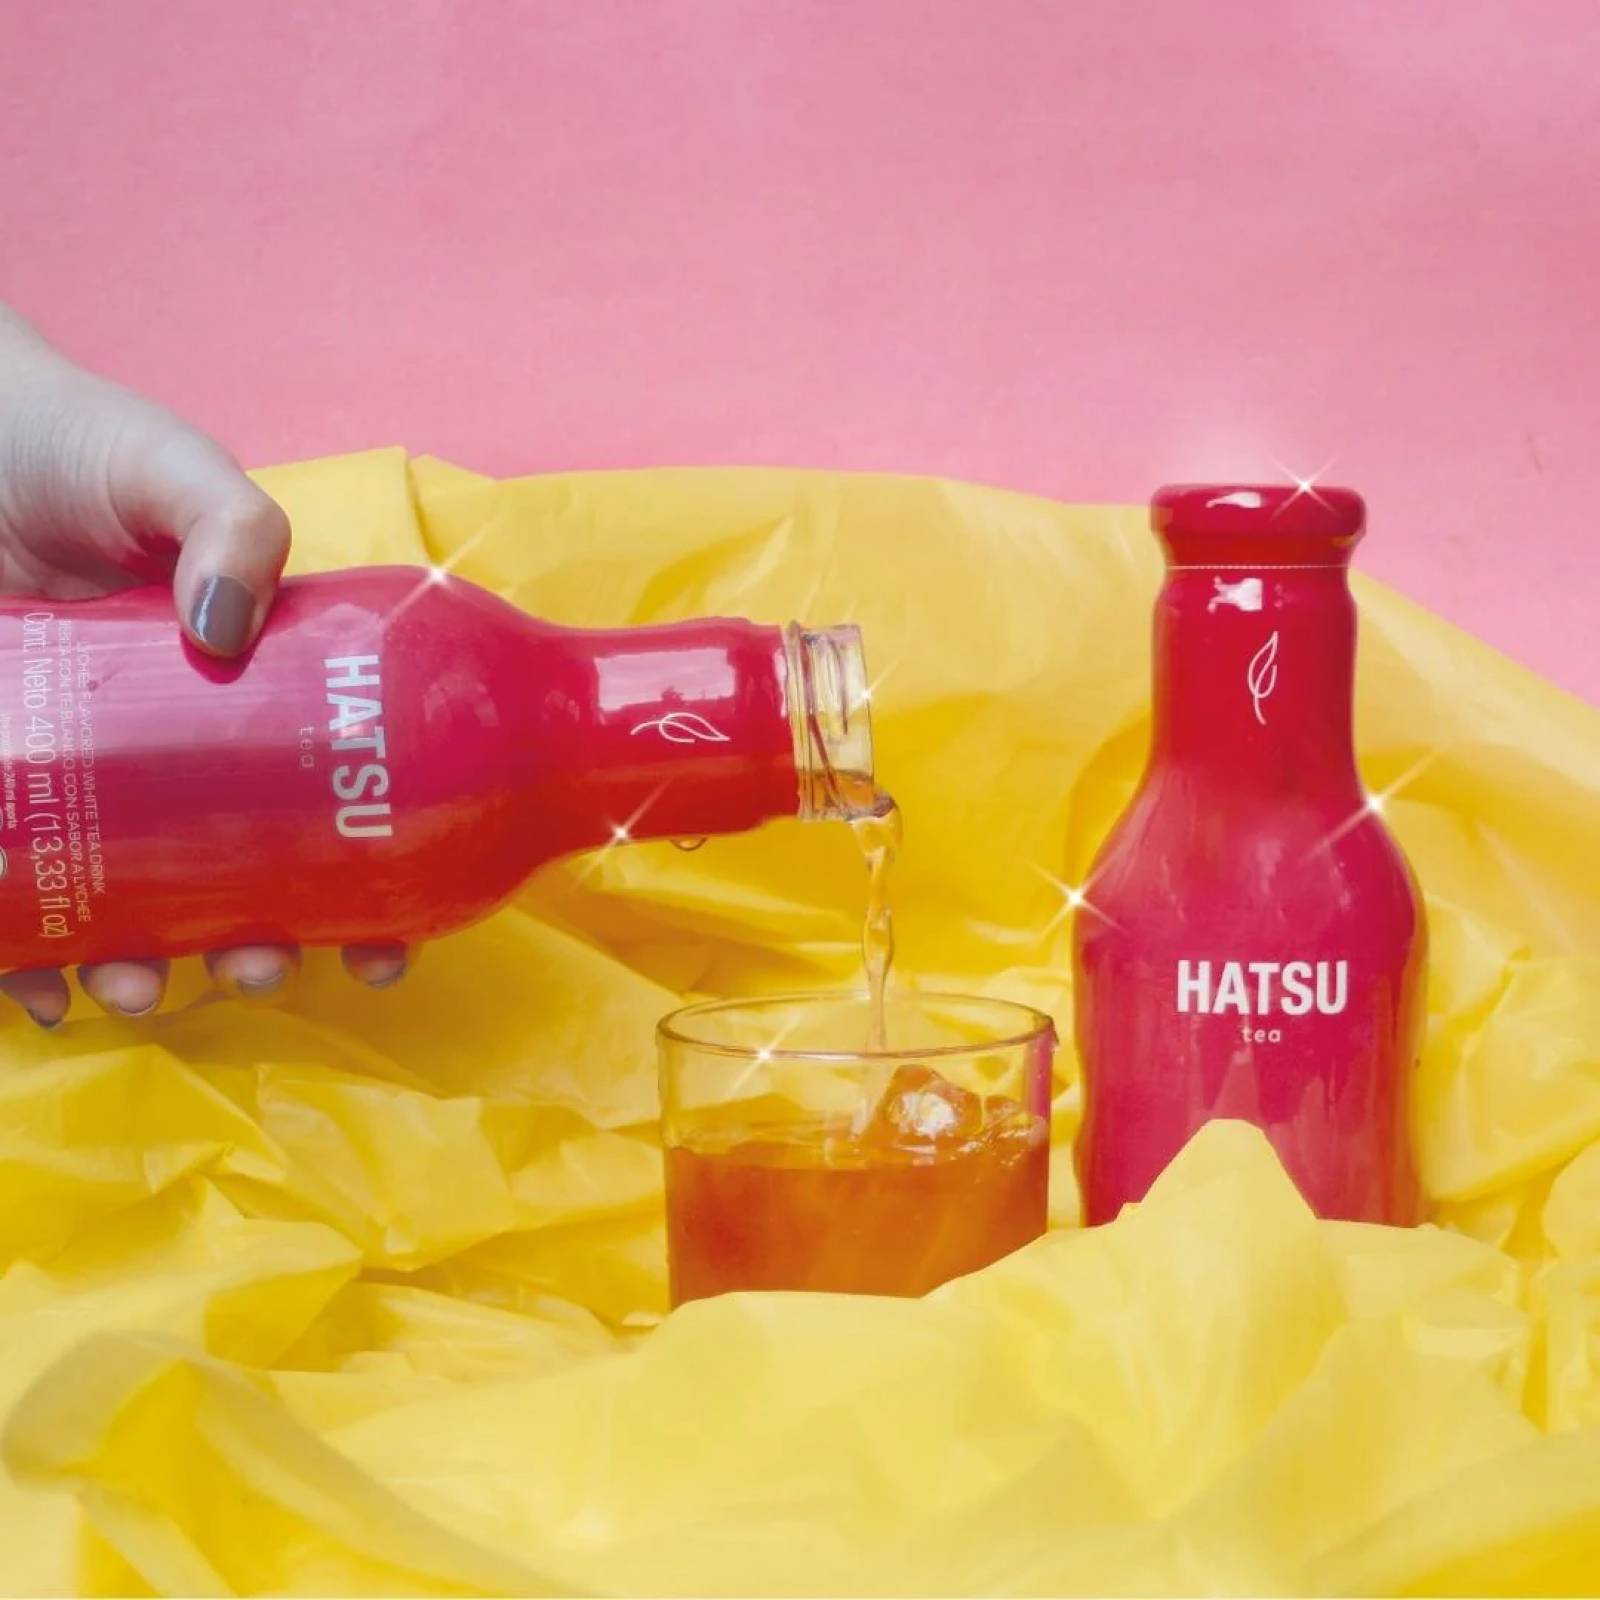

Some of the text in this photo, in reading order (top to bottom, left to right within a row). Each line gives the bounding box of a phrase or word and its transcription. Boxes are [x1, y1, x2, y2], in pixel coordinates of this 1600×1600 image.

[24, 658, 54, 709] Neto
[24, 716, 56, 764] 400
[298, 726, 315, 768] tea
[324, 655, 393, 838] HATSU
[27, 772, 60, 804] ml
[63, 773, 78, 808] CON
[83, 771, 97, 820] WHITE
[24, 813, 67, 891] (13,33
[67, 812, 82, 861] SABOR
[87, 823, 101, 851] TEA
[72, 864, 84, 874] A
[90, 854, 105, 895] DRINK
[40, 896, 71, 909] fl
[73, 876, 91, 922] LYCHEE
[40, 914, 75, 938] oz)
[1177, 959, 1347, 1015] HATSU
[1242, 1026, 1280, 1043] tea
